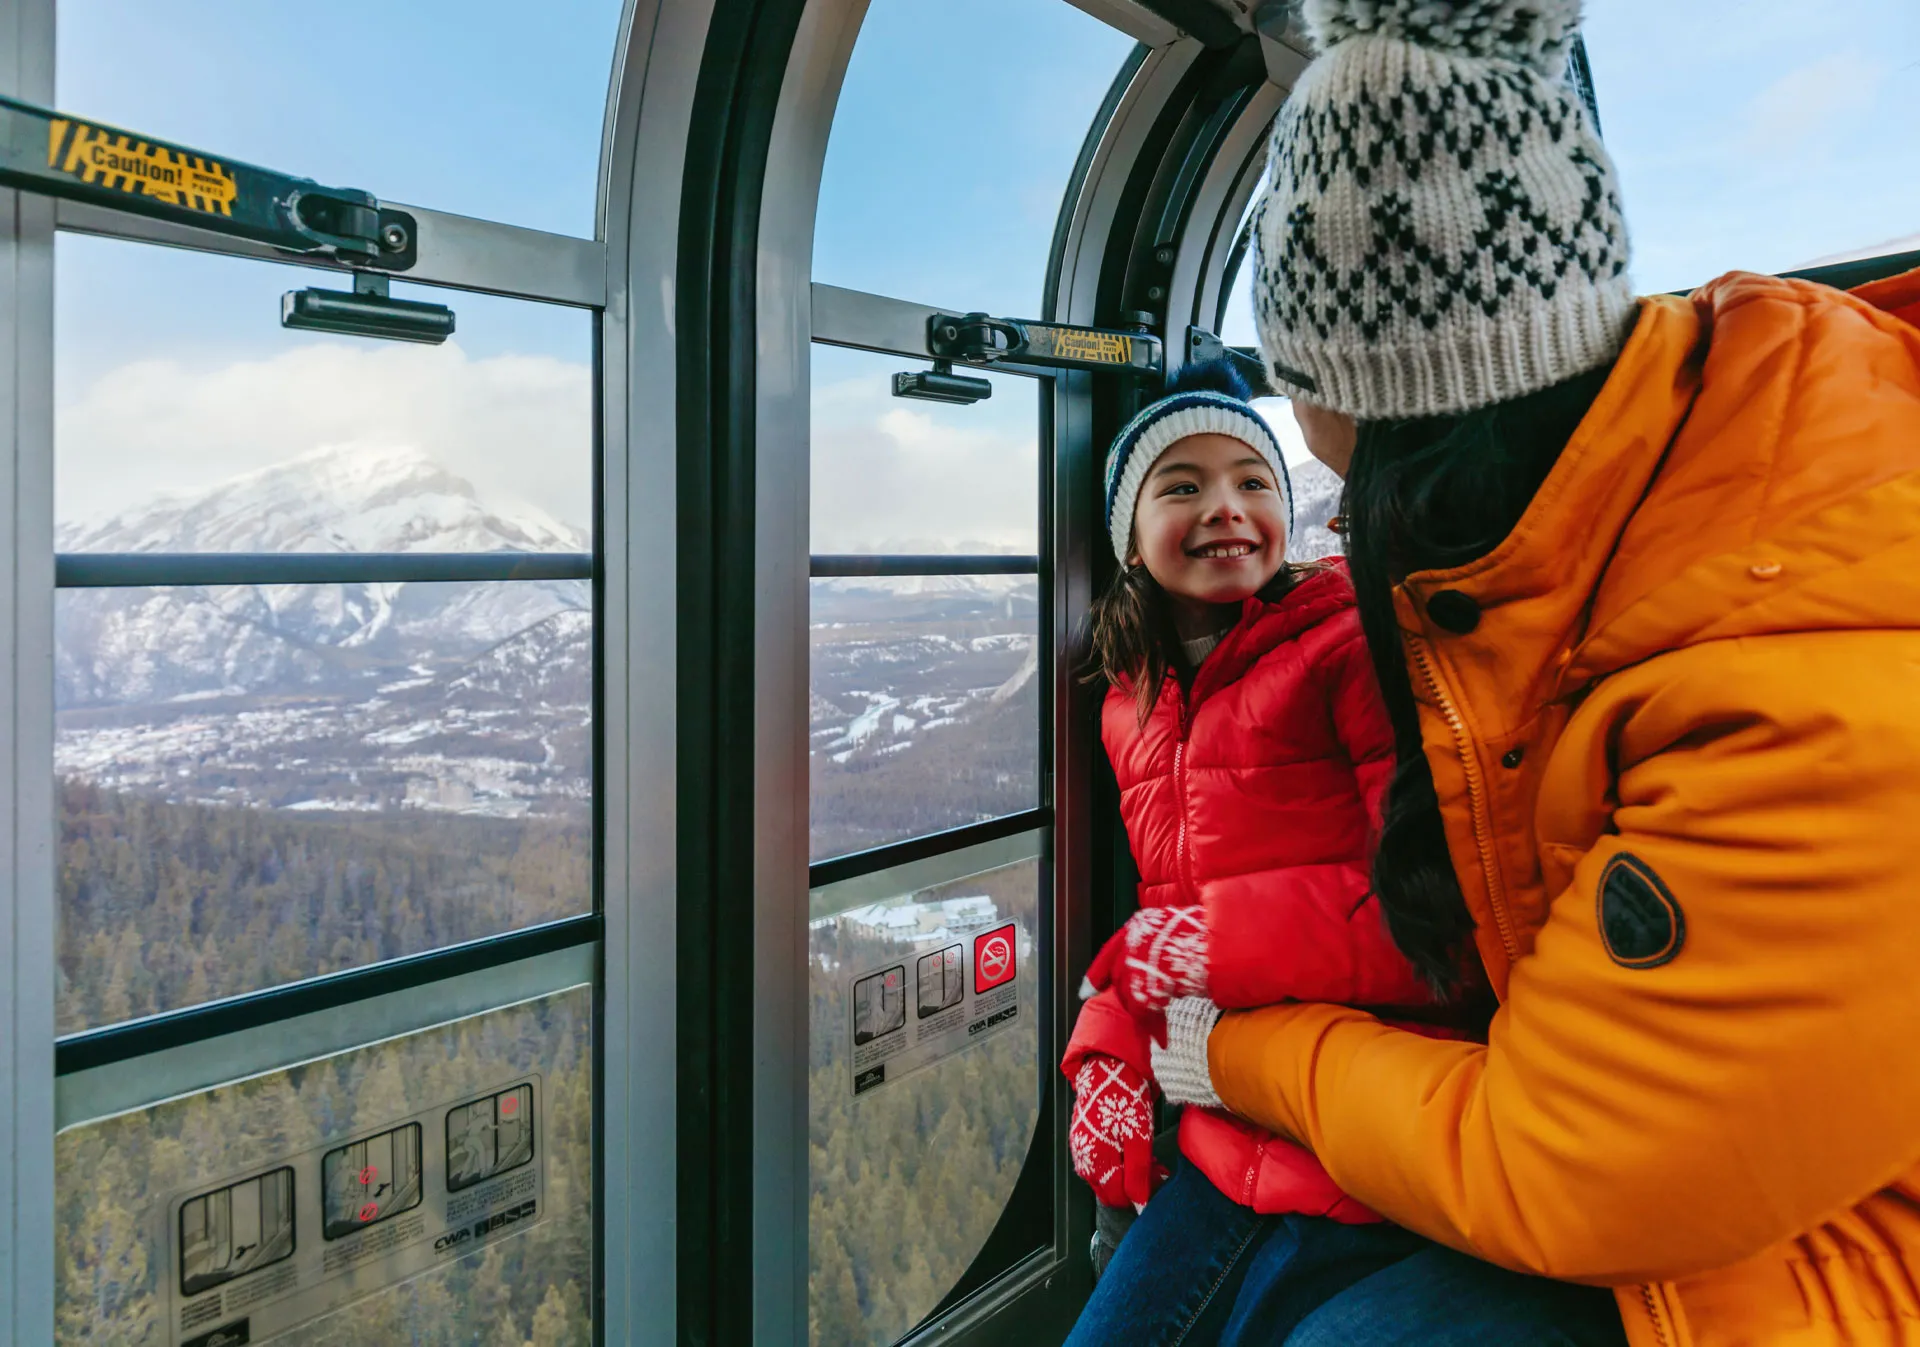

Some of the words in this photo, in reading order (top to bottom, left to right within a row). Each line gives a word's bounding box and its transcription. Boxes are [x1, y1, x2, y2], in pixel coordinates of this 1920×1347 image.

[91, 145, 182, 186] Caution!
[1065, 336, 1099, 350] Caution!
[434, 1228, 471, 1249] CWA
